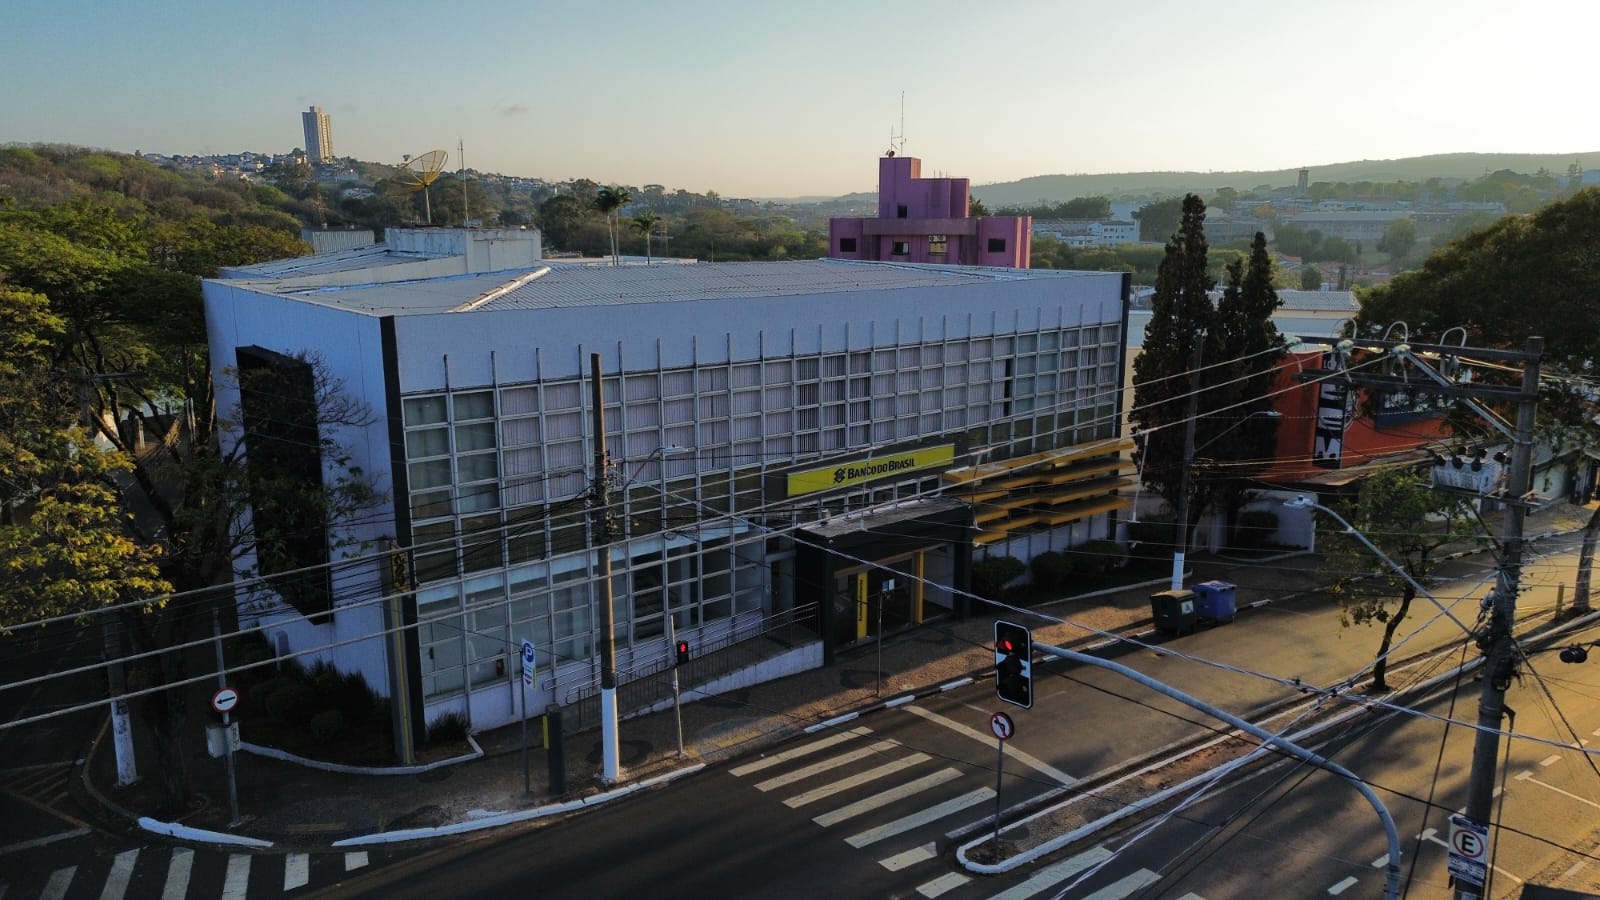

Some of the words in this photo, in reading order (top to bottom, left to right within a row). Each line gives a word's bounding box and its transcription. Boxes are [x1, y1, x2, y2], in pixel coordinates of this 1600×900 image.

[848, 465, 876, 480] BANCO
[877, 463, 888, 474] DO
[889, 458, 915, 471] BRASIL
[1461, 833, 1474, 854] E
